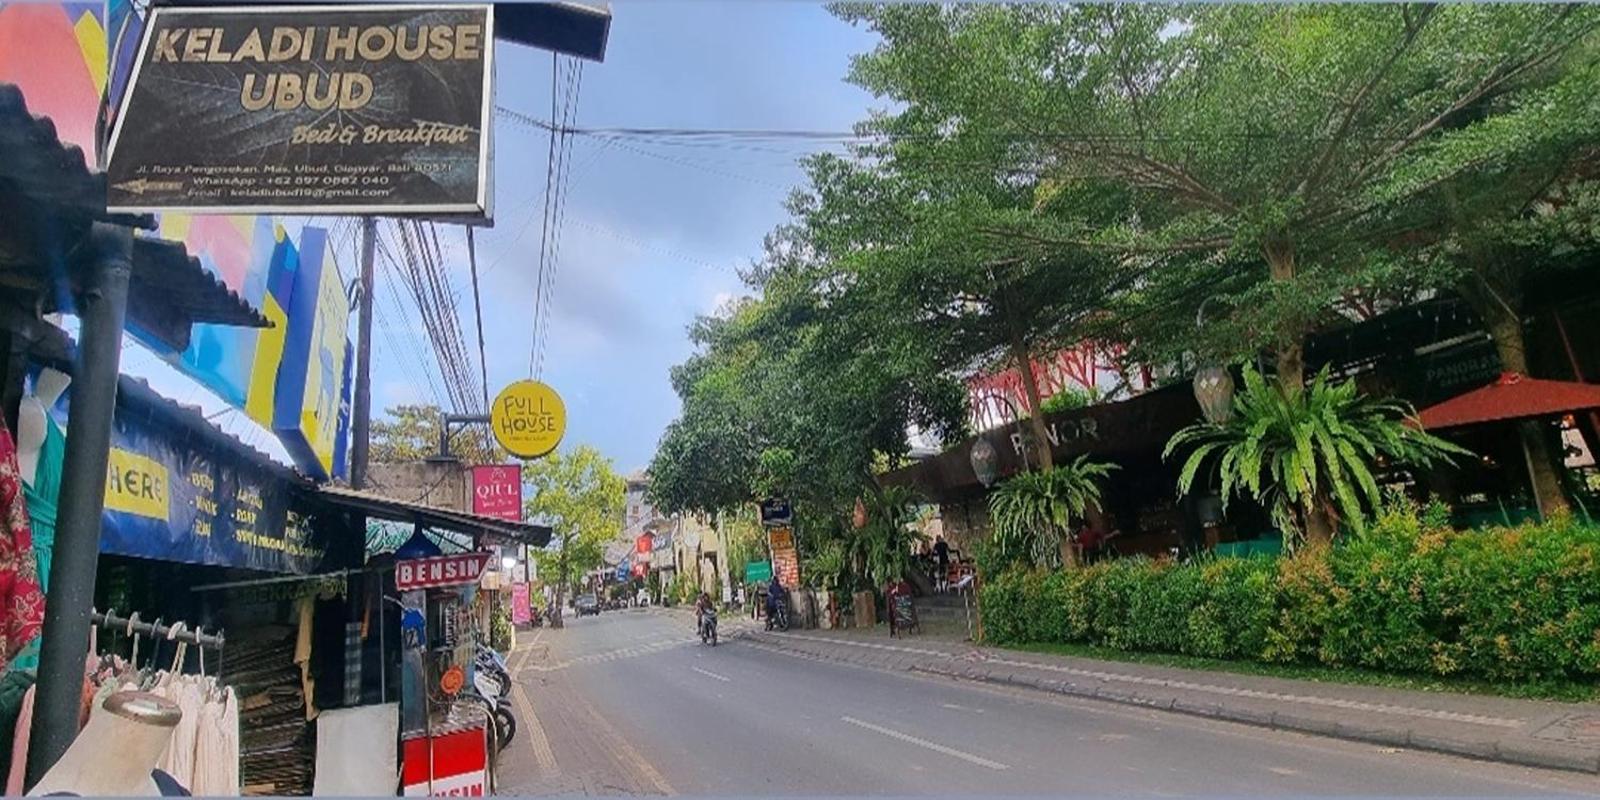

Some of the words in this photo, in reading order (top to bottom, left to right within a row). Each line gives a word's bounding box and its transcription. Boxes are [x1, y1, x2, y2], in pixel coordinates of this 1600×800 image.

[151, 25, 315, 63] KELADI
[325, 23, 481, 61] HOUSE
[240, 72, 374, 111] UBUD
[291, 123, 338, 145] Bed
[338, 125, 358, 145] &
[362, 121, 468, 146] Breakfast
[193, 177, 256, 187] WhatsApp
[361, 176, 389, 185] 040
[503, 395, 551, 417] FULL
[501, 416, 556, 435] HOUSE
[109, 463, 163, 503] HERE
[400, 559, 480, 583] BENSIN
